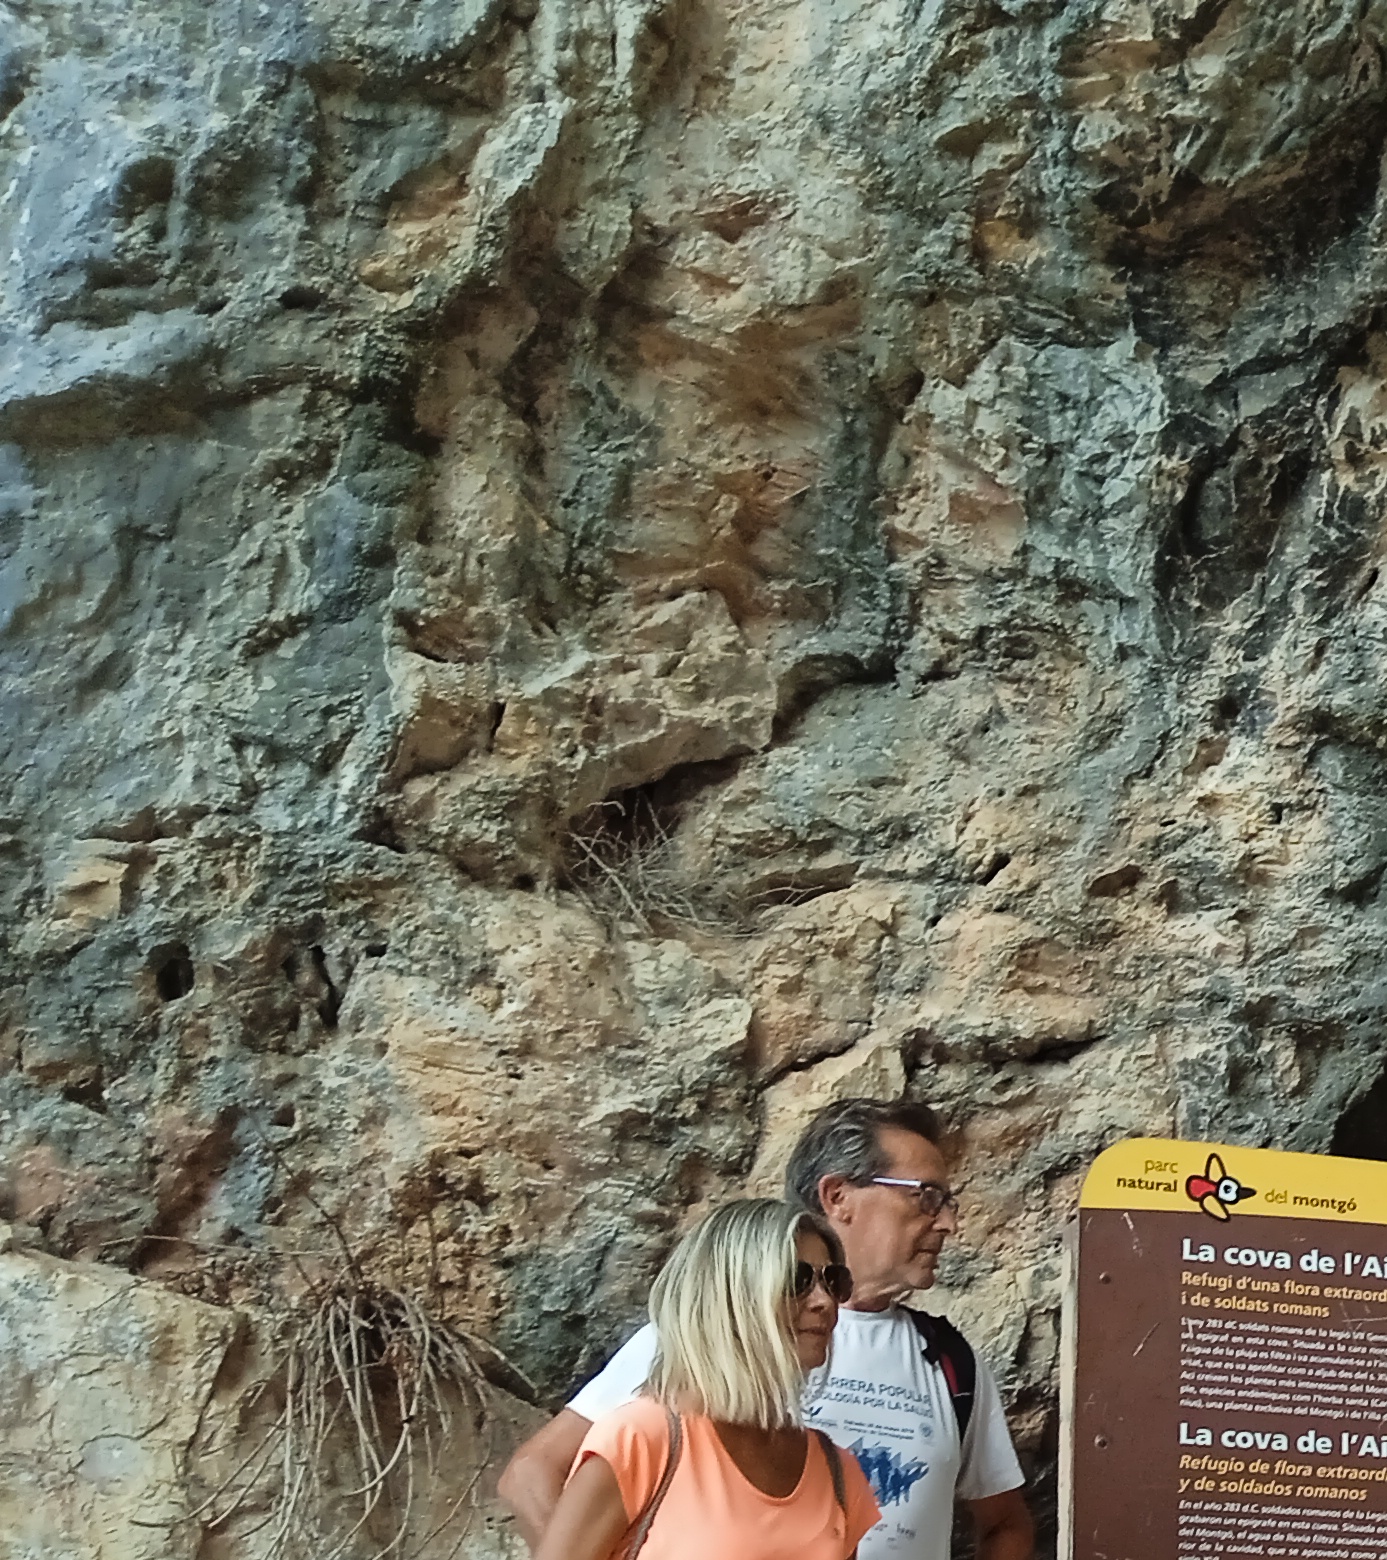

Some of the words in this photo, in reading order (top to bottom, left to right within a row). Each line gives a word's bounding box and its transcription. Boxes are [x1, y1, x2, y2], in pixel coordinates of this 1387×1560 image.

[1144, 1160, 1178, 1174] parc
[1116, 1178, 1177, 1192] natural
[1265, 1189, 1287, 1204] del
[1293, 1196, 1356, 1212] montgó
[1182, 1238, 1215, 1262] La
[1223, 1247, 1291, 1270] cova
[1299, 1249, 1335, 1274] de
[1181, 1271, 1233, 1291] Refugi
[1236, 1276, 1280, 1292] d'una
[1283, 1280, 1320, 1296] flora
[1181, 1290, 1187, 1305] i
[1190, 1292, 1211, 1307] de
[1214, 1295, 1269, 1312] soldats
[1273, 1302, 1329, 1317] romans
[812, 1376, 876, 1394] CRRERA
[887, 1401, 902, 1410] LA
[1179, 1422, 1212, 1445] La
[1220, 1430, 1288, 1451] cova
[1296, 1430, 1332, 1454] de
[1179, 1454, 1245, 1475] Refugio
[1248, 1459, 1270, 1474] de
[1274, 1460, 1313, 1476] flora
[1177, 1478, 1191, 1493] y
[1194, 1478, 1216, 1491] de
[1218, 1480, 1293, 1496] soldados
[1295, 1485, 1367, 1501] romanos
